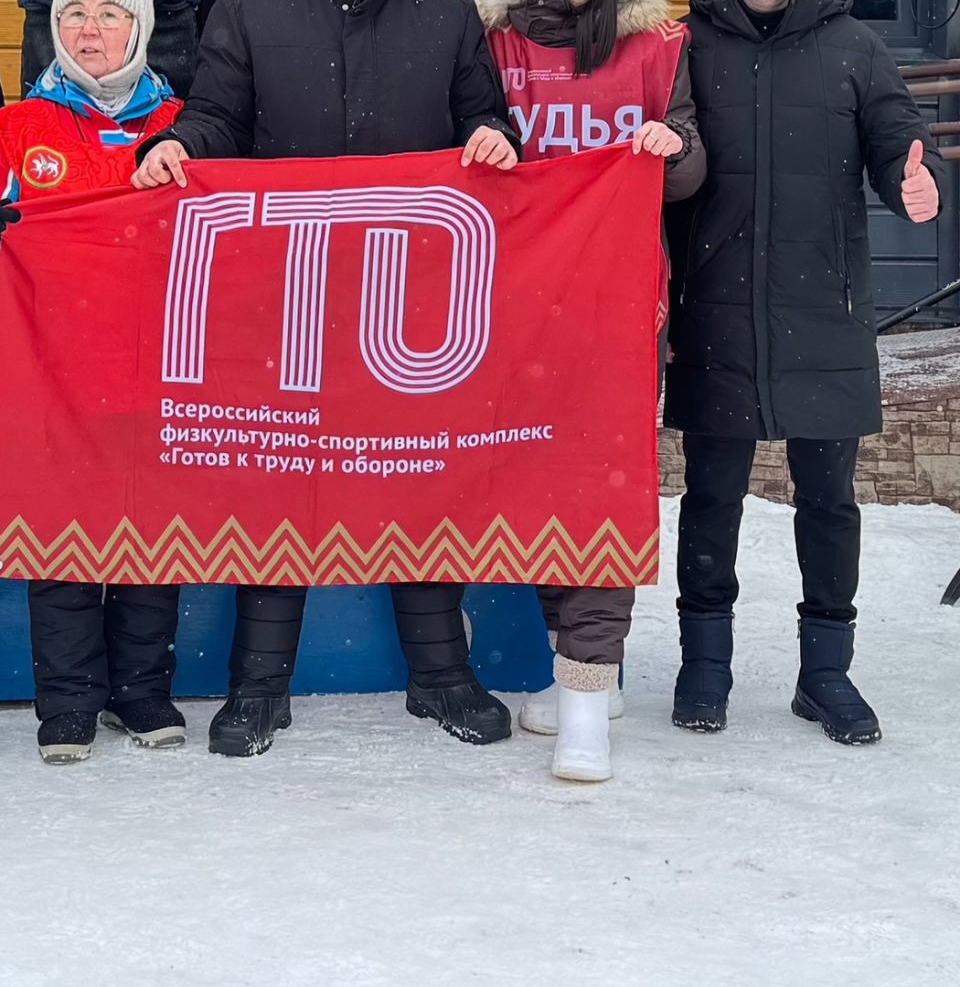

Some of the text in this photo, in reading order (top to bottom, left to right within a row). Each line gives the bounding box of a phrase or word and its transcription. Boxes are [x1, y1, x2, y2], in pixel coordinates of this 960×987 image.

[507, 103, 644, 154] УДЬЯ
[161, 185, 497, 395] ГТО
[160, 398, 321, 426] Всероссийский
[160, 423, 553, 454] физкультурно-спортивный комплекс
[159, 447, 446, 478] «Готов к труду и обороне»
